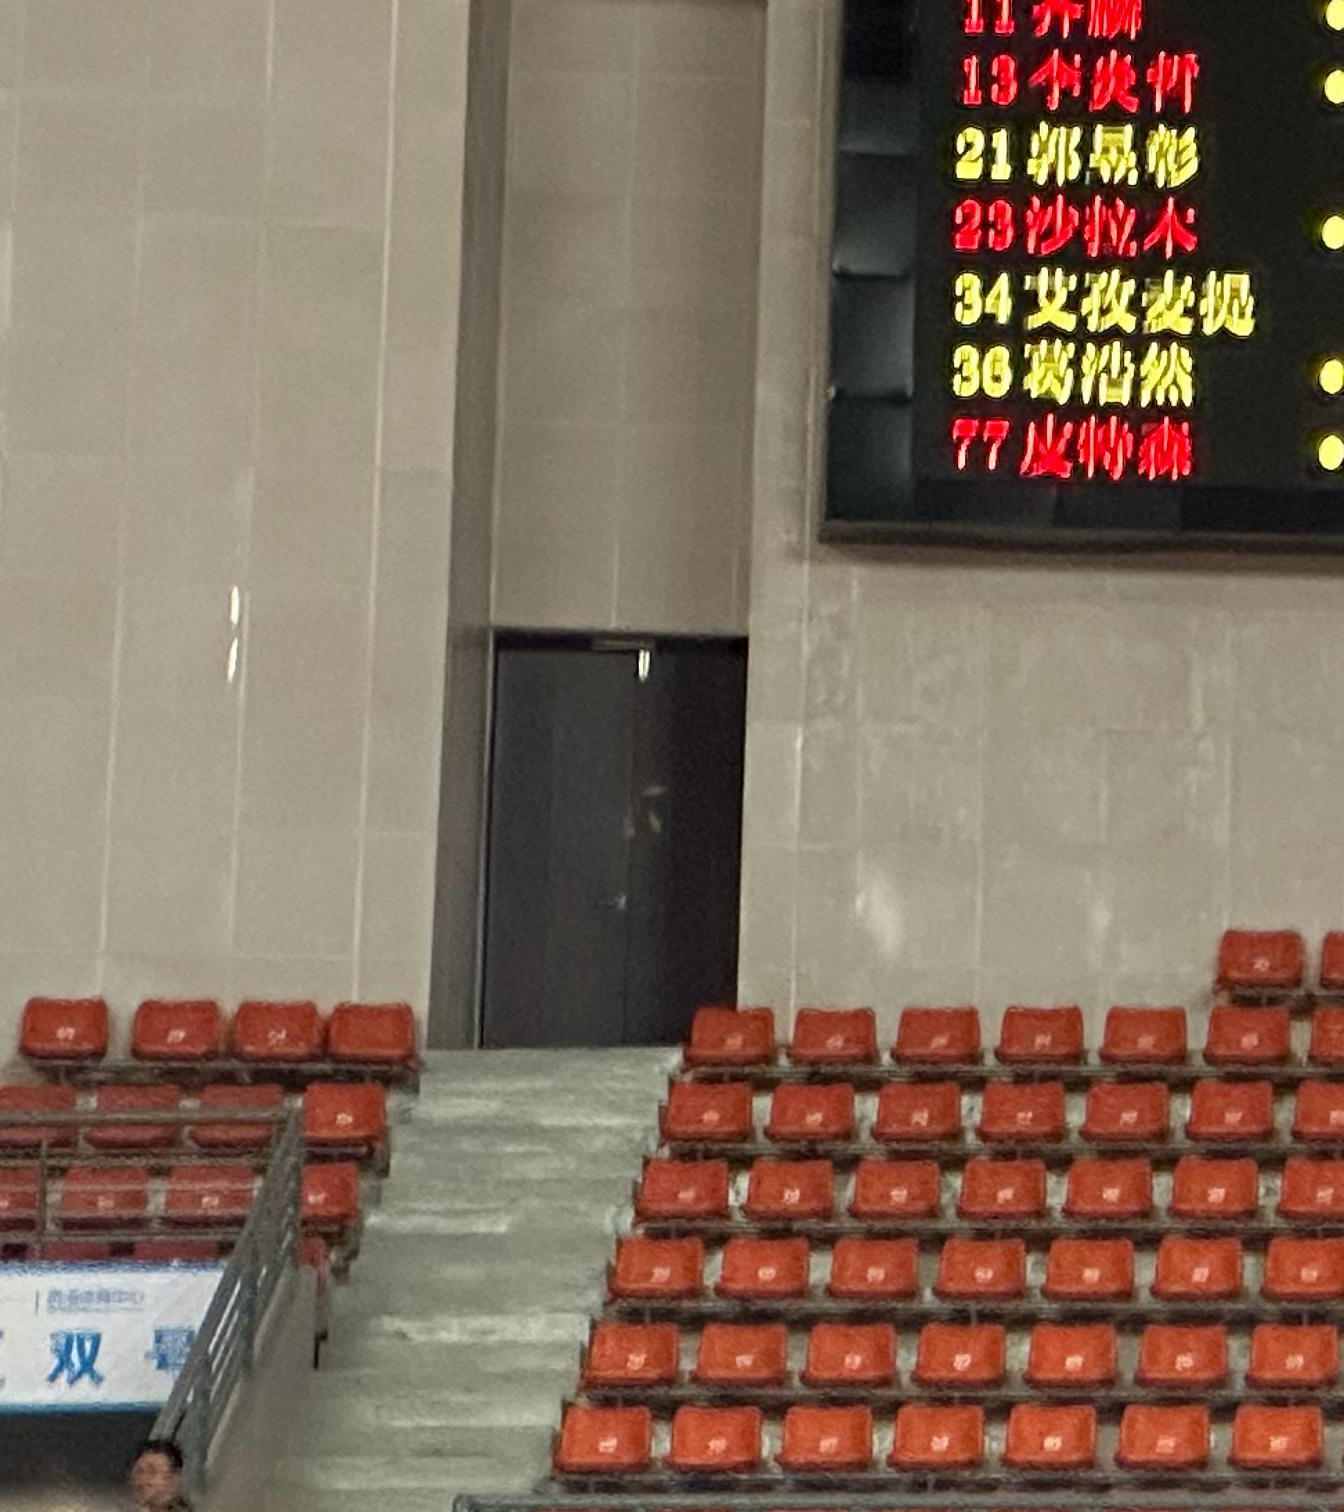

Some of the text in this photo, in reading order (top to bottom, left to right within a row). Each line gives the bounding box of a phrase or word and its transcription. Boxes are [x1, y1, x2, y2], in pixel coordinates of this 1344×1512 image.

[963, 55, 1018, 105] 13
[956, 127, 1011, 179] 21
[954, 199, 1015, 251] 23
[955, 272, 1012, 325] 34
[952, 418, 1009, 470] 77
